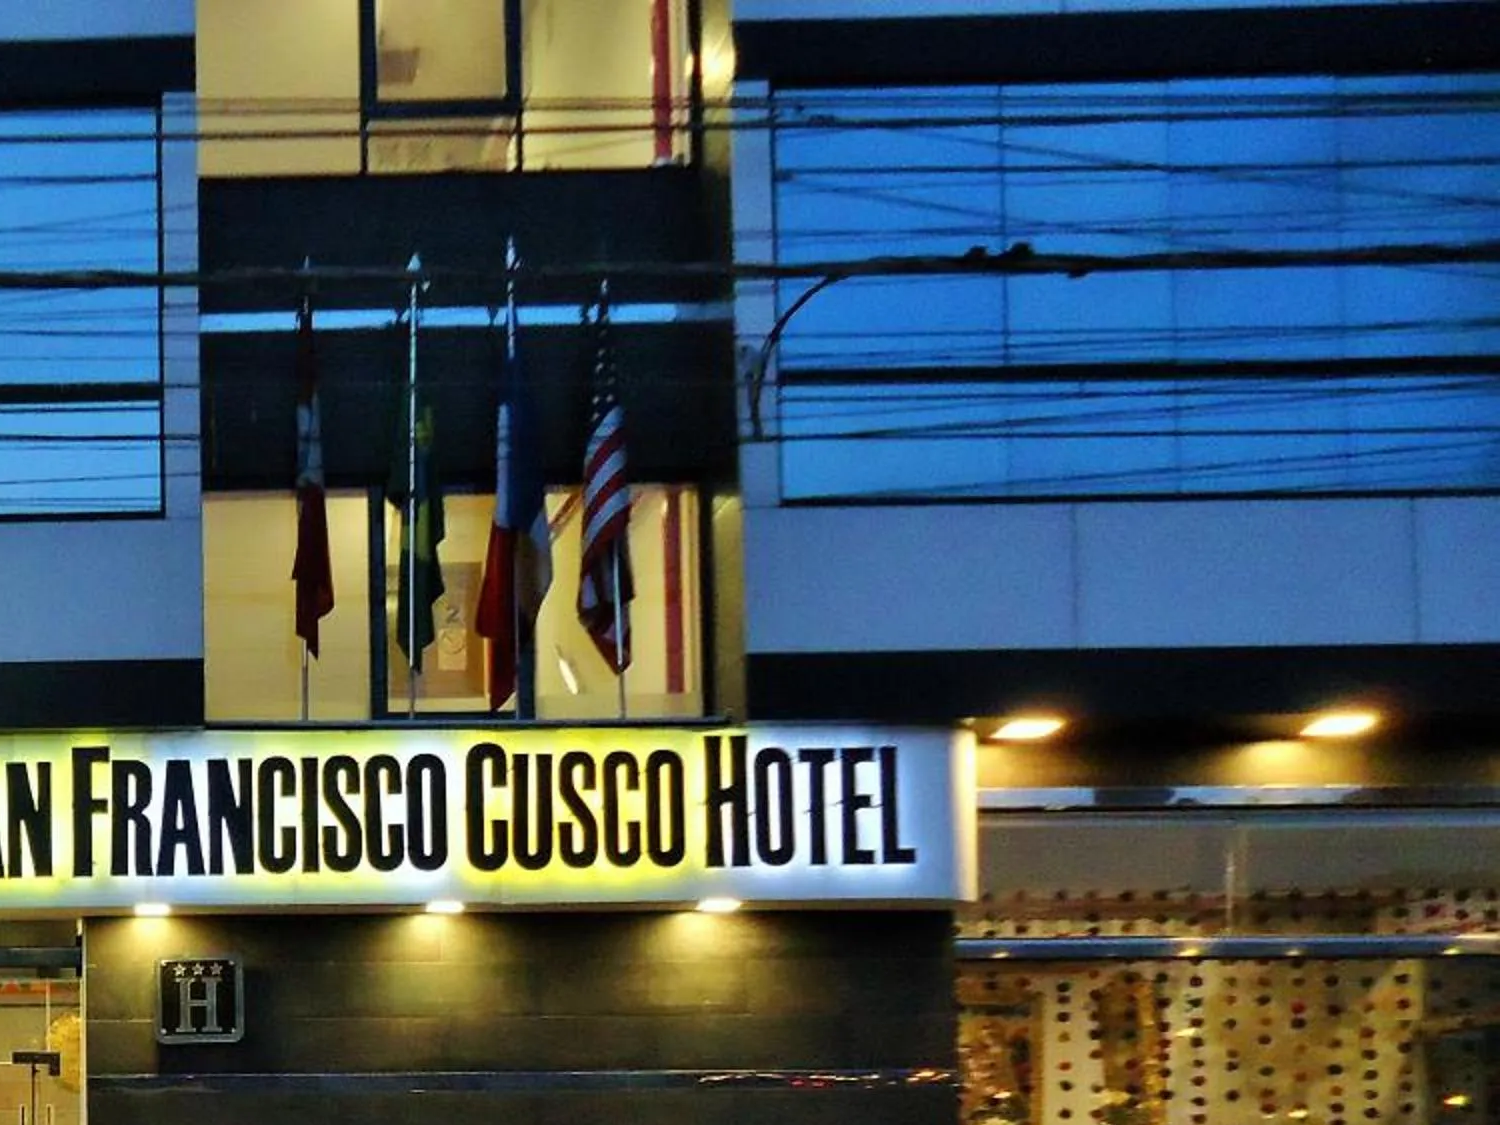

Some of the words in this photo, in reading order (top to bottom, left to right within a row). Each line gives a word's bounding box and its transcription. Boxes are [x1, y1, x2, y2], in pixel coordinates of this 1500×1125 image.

[72, 746, 448, 877] FRANCISCO
[466, 742, 685, 872] CUSCO
[704, 735, 916, 868] HOTEL
[175, 977, 223, 1033] H
